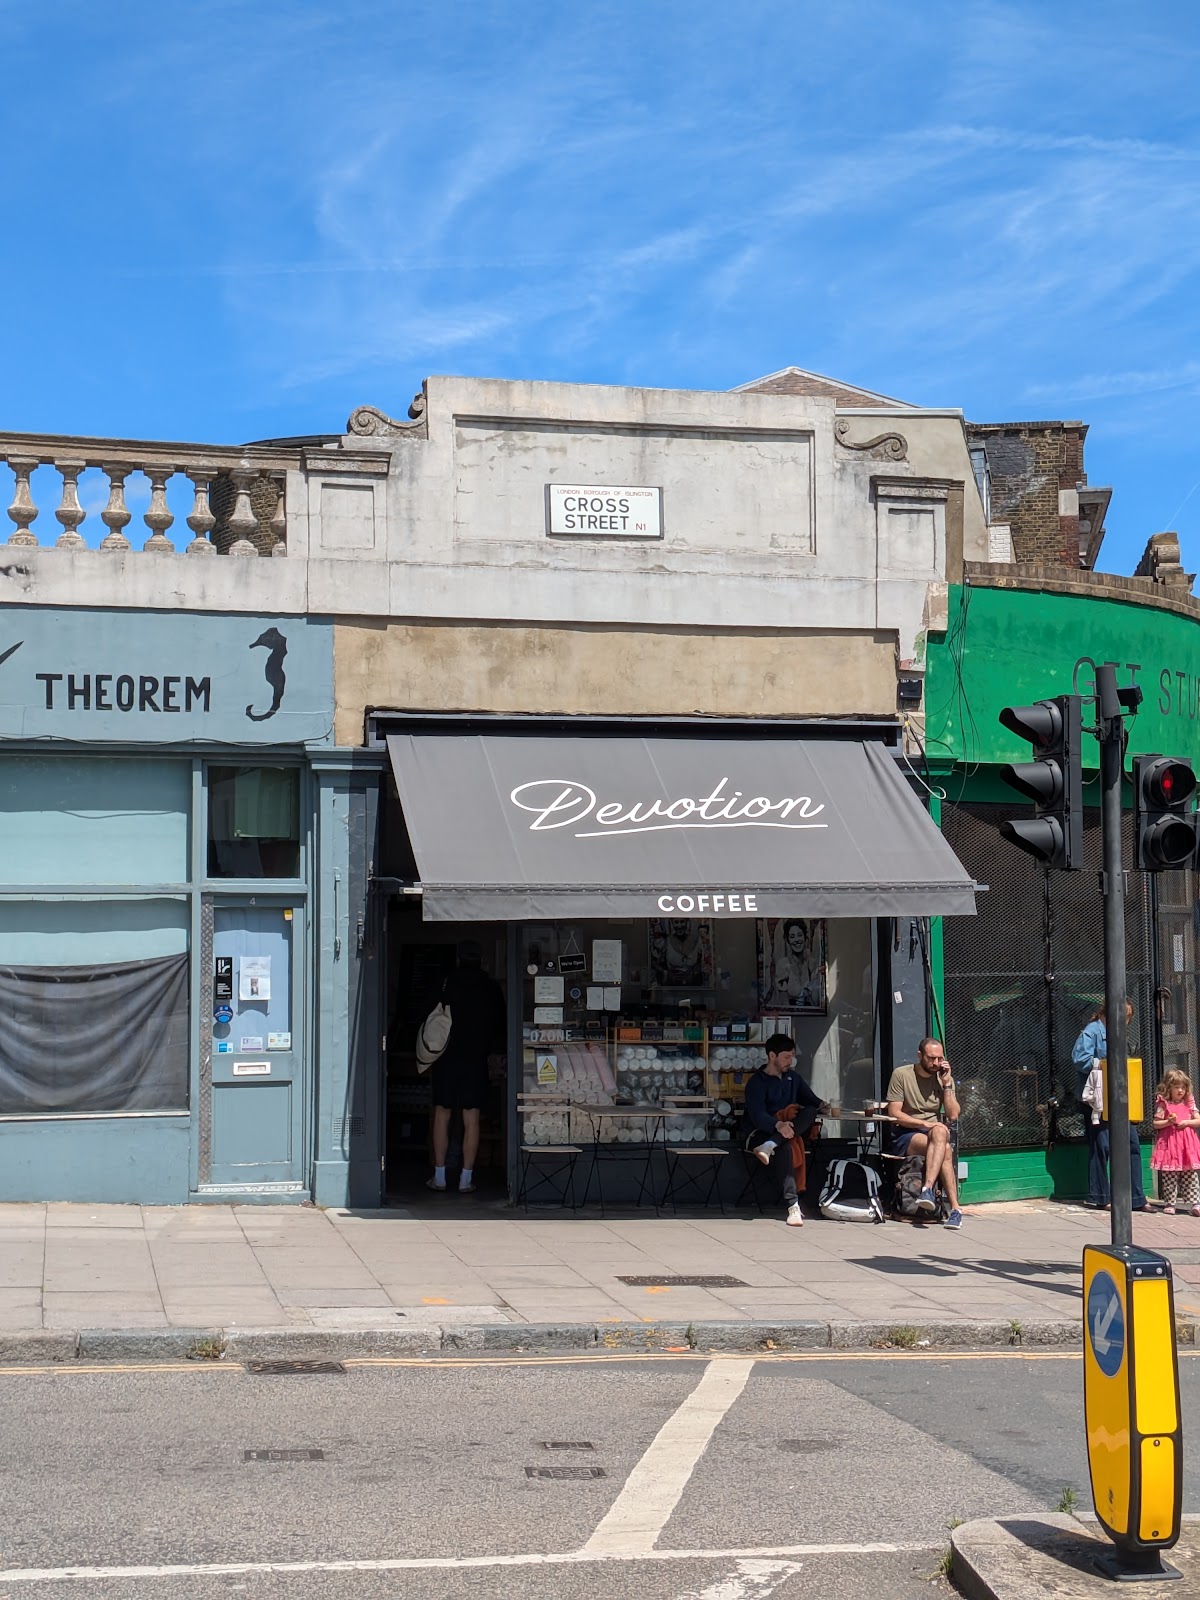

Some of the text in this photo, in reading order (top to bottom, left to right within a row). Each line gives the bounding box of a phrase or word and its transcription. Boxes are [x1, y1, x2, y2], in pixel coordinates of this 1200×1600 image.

[564, 497, 629, 513] CROSS
[565, 514, 646, 531] STREET N1
[1072, 656, 1142, 705] GT
[36, 673, 211, 713] THEOREM
[510, 777, 825, 832] Devotion
[249, 897, 256, 906] 4
[657, 894, 758, 913] COFFEE
[530, 1029, 572, 1042] OZONE
